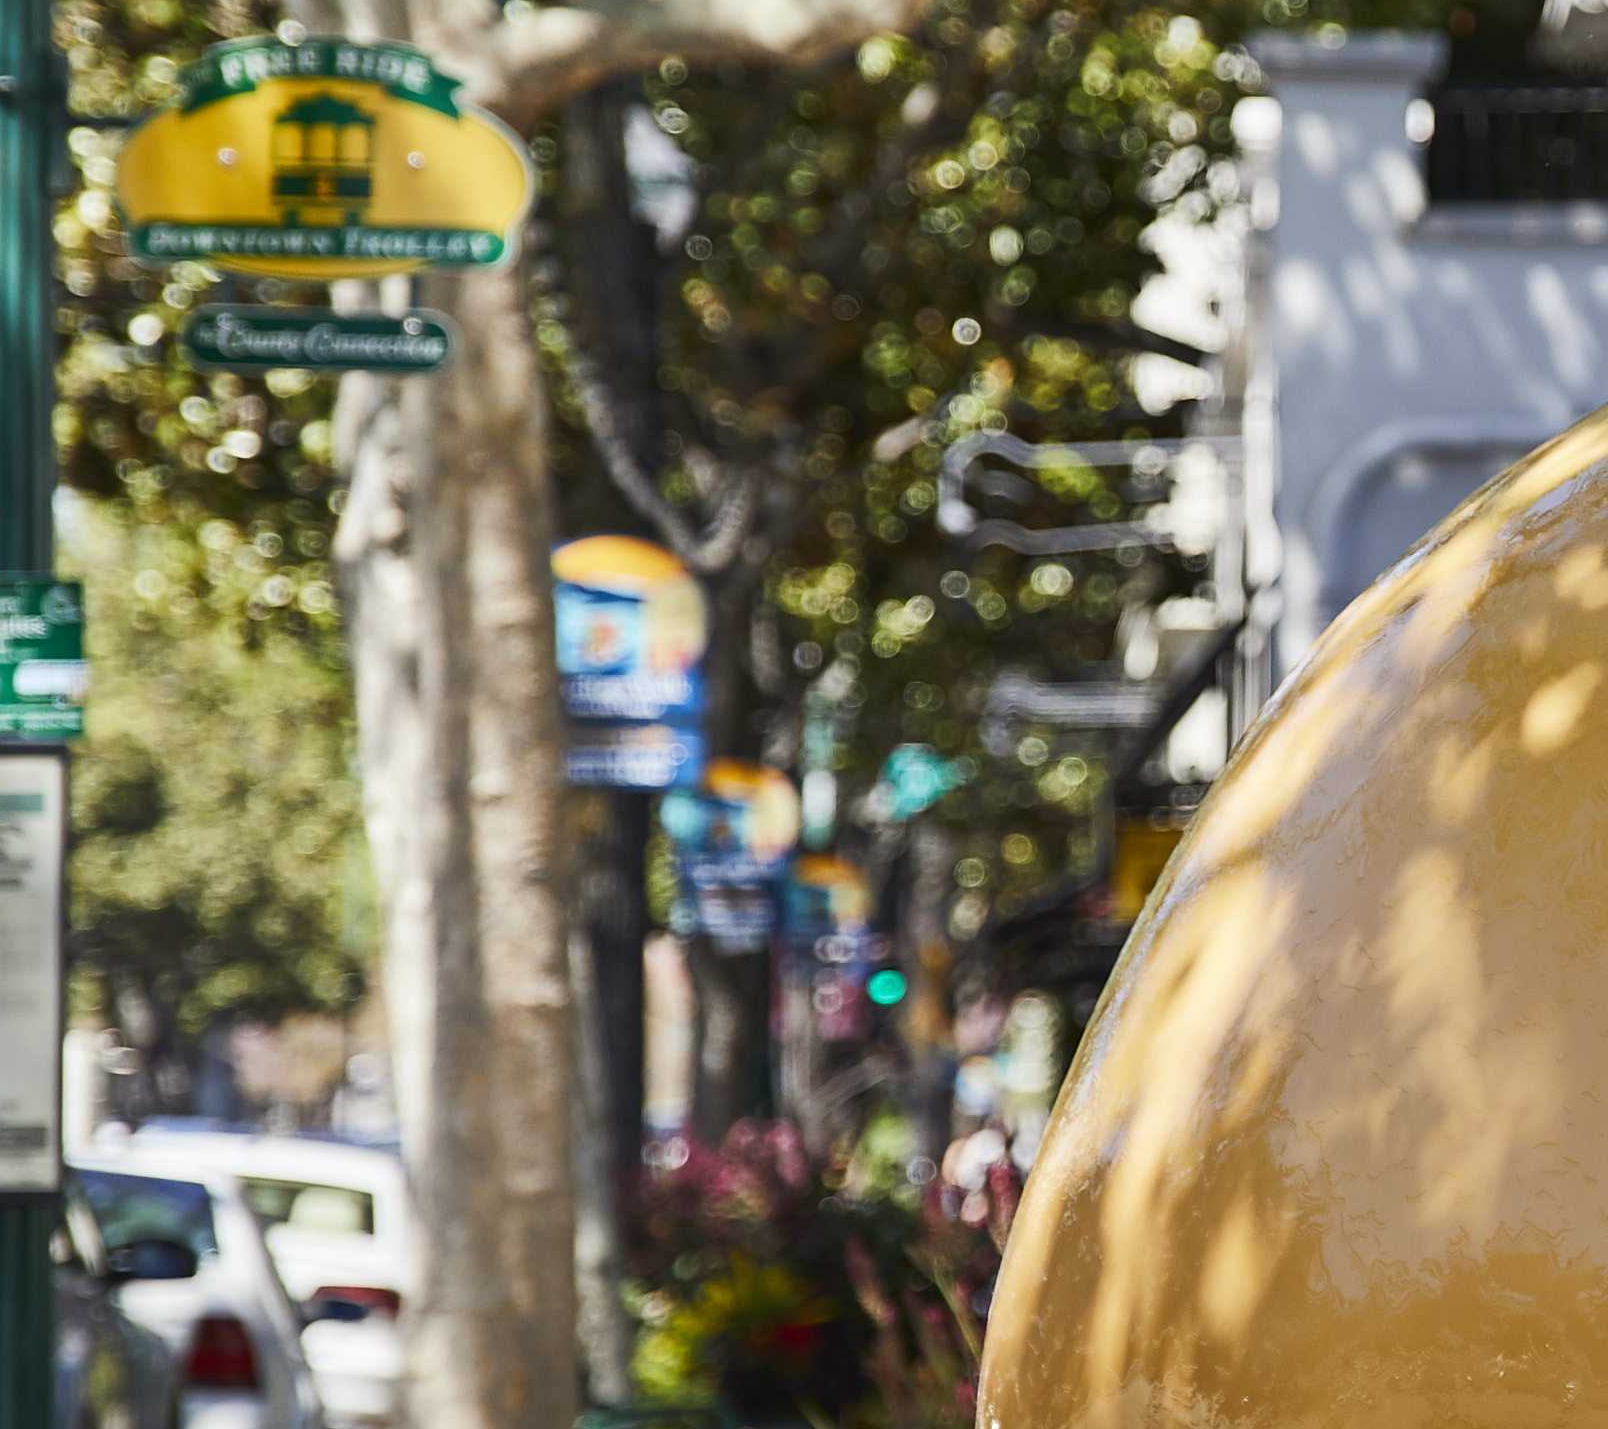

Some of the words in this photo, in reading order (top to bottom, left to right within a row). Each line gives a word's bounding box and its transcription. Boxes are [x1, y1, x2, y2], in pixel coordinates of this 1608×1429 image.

[220, 46, 322, 89] FREE
[336, 47, 433, 95] RIDE
[344, 226, 496, 264] TROLLEY
